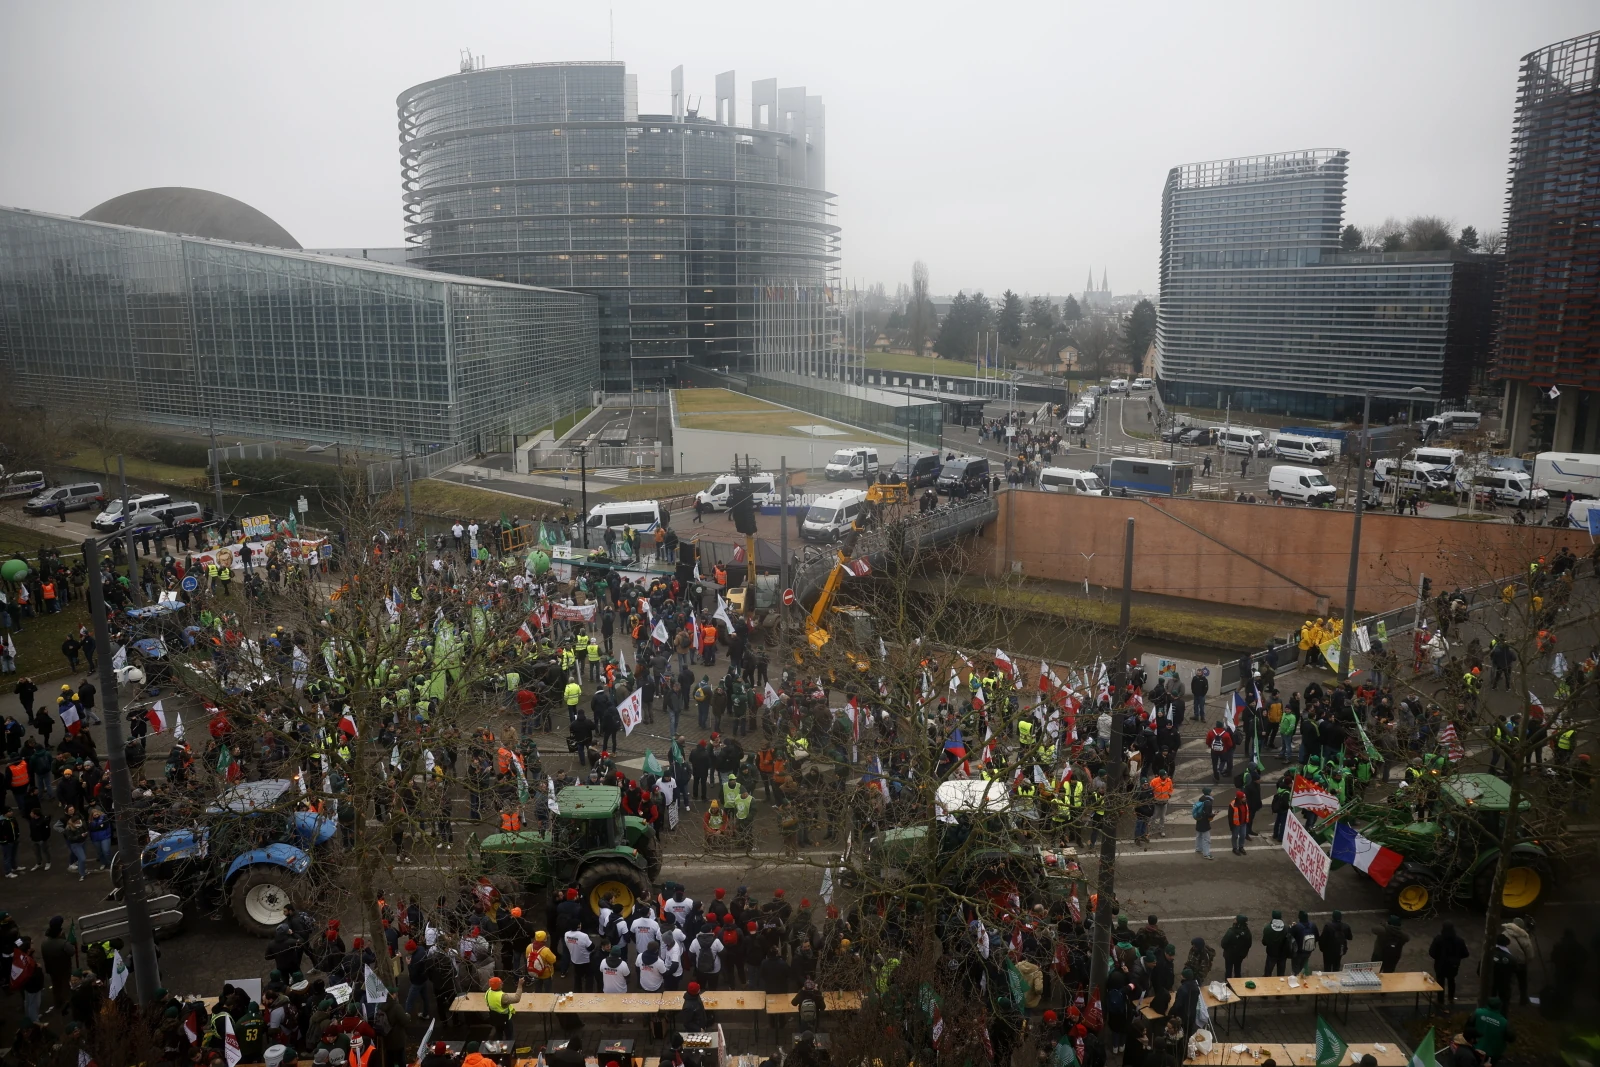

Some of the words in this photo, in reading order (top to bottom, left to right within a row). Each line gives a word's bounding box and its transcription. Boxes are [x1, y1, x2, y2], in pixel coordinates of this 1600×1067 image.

[243, 515, 267, 527] STOP
[234, 549, 263, 557] SOP
[1287, 831, 1293, 845] NE
[1293, 840, 1306, 857] DOIT
[1288, 814, 1307, 847] NOTRE
[1308, 840, 1325, 869] FUTUR
[1288, 845, 1297, 863] UNE
[1298, 856, 1323, 895] TORTURE
[245, 1028, 259, 1042] 53
